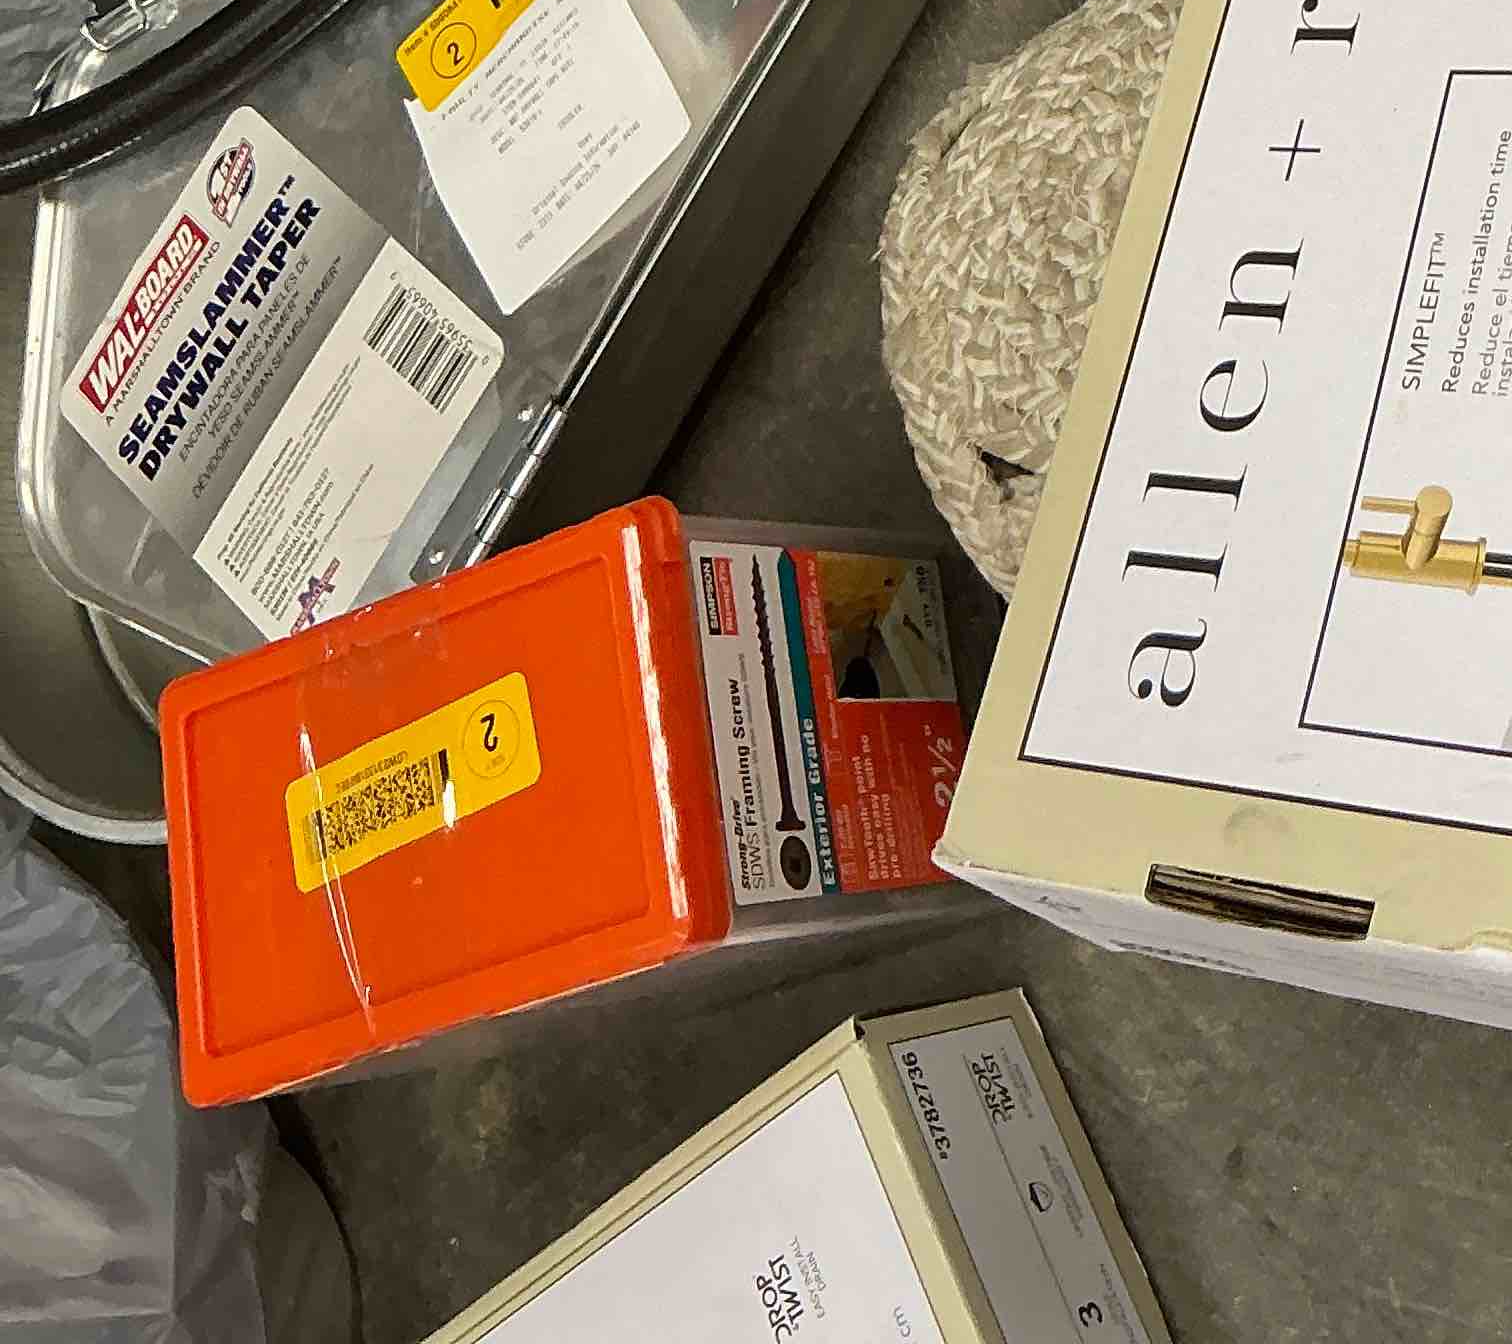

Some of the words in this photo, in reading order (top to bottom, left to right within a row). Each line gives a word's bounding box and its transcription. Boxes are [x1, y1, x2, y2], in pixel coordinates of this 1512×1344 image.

[446, 41, 465, 66] 2
[1441, 301, 1475, 392] Reduces
[1462, 182, 1501, 293] installation
[1490, 129, 1512, 175] time
[138, 317, 249, 481] DRYWALL
[240, 198, 321, 309] TAPER
[1471, 313, 1505, 394] Reduce
[1122, 239, 1304, 707] allen
[1268, 118, 1321, 181] +
[699, 560, 721, 630] SIMPSON
[479, 713, 498, 752] 2
[728, 678, 745, 738] Screw
[737, 745, 757, 826] Framing
[802, 718, 820, 784] Grade
[746, 832, 764, 888] SDWS
[813, 791, 835, 884] Exterior
[901, 1051, 950, 1159] #3782736
[980, 1053, 1015, 1113] TWIST
[768, 1254, 804, 1325] TWIST
[1078, 1301, 1102, 1327] 3
